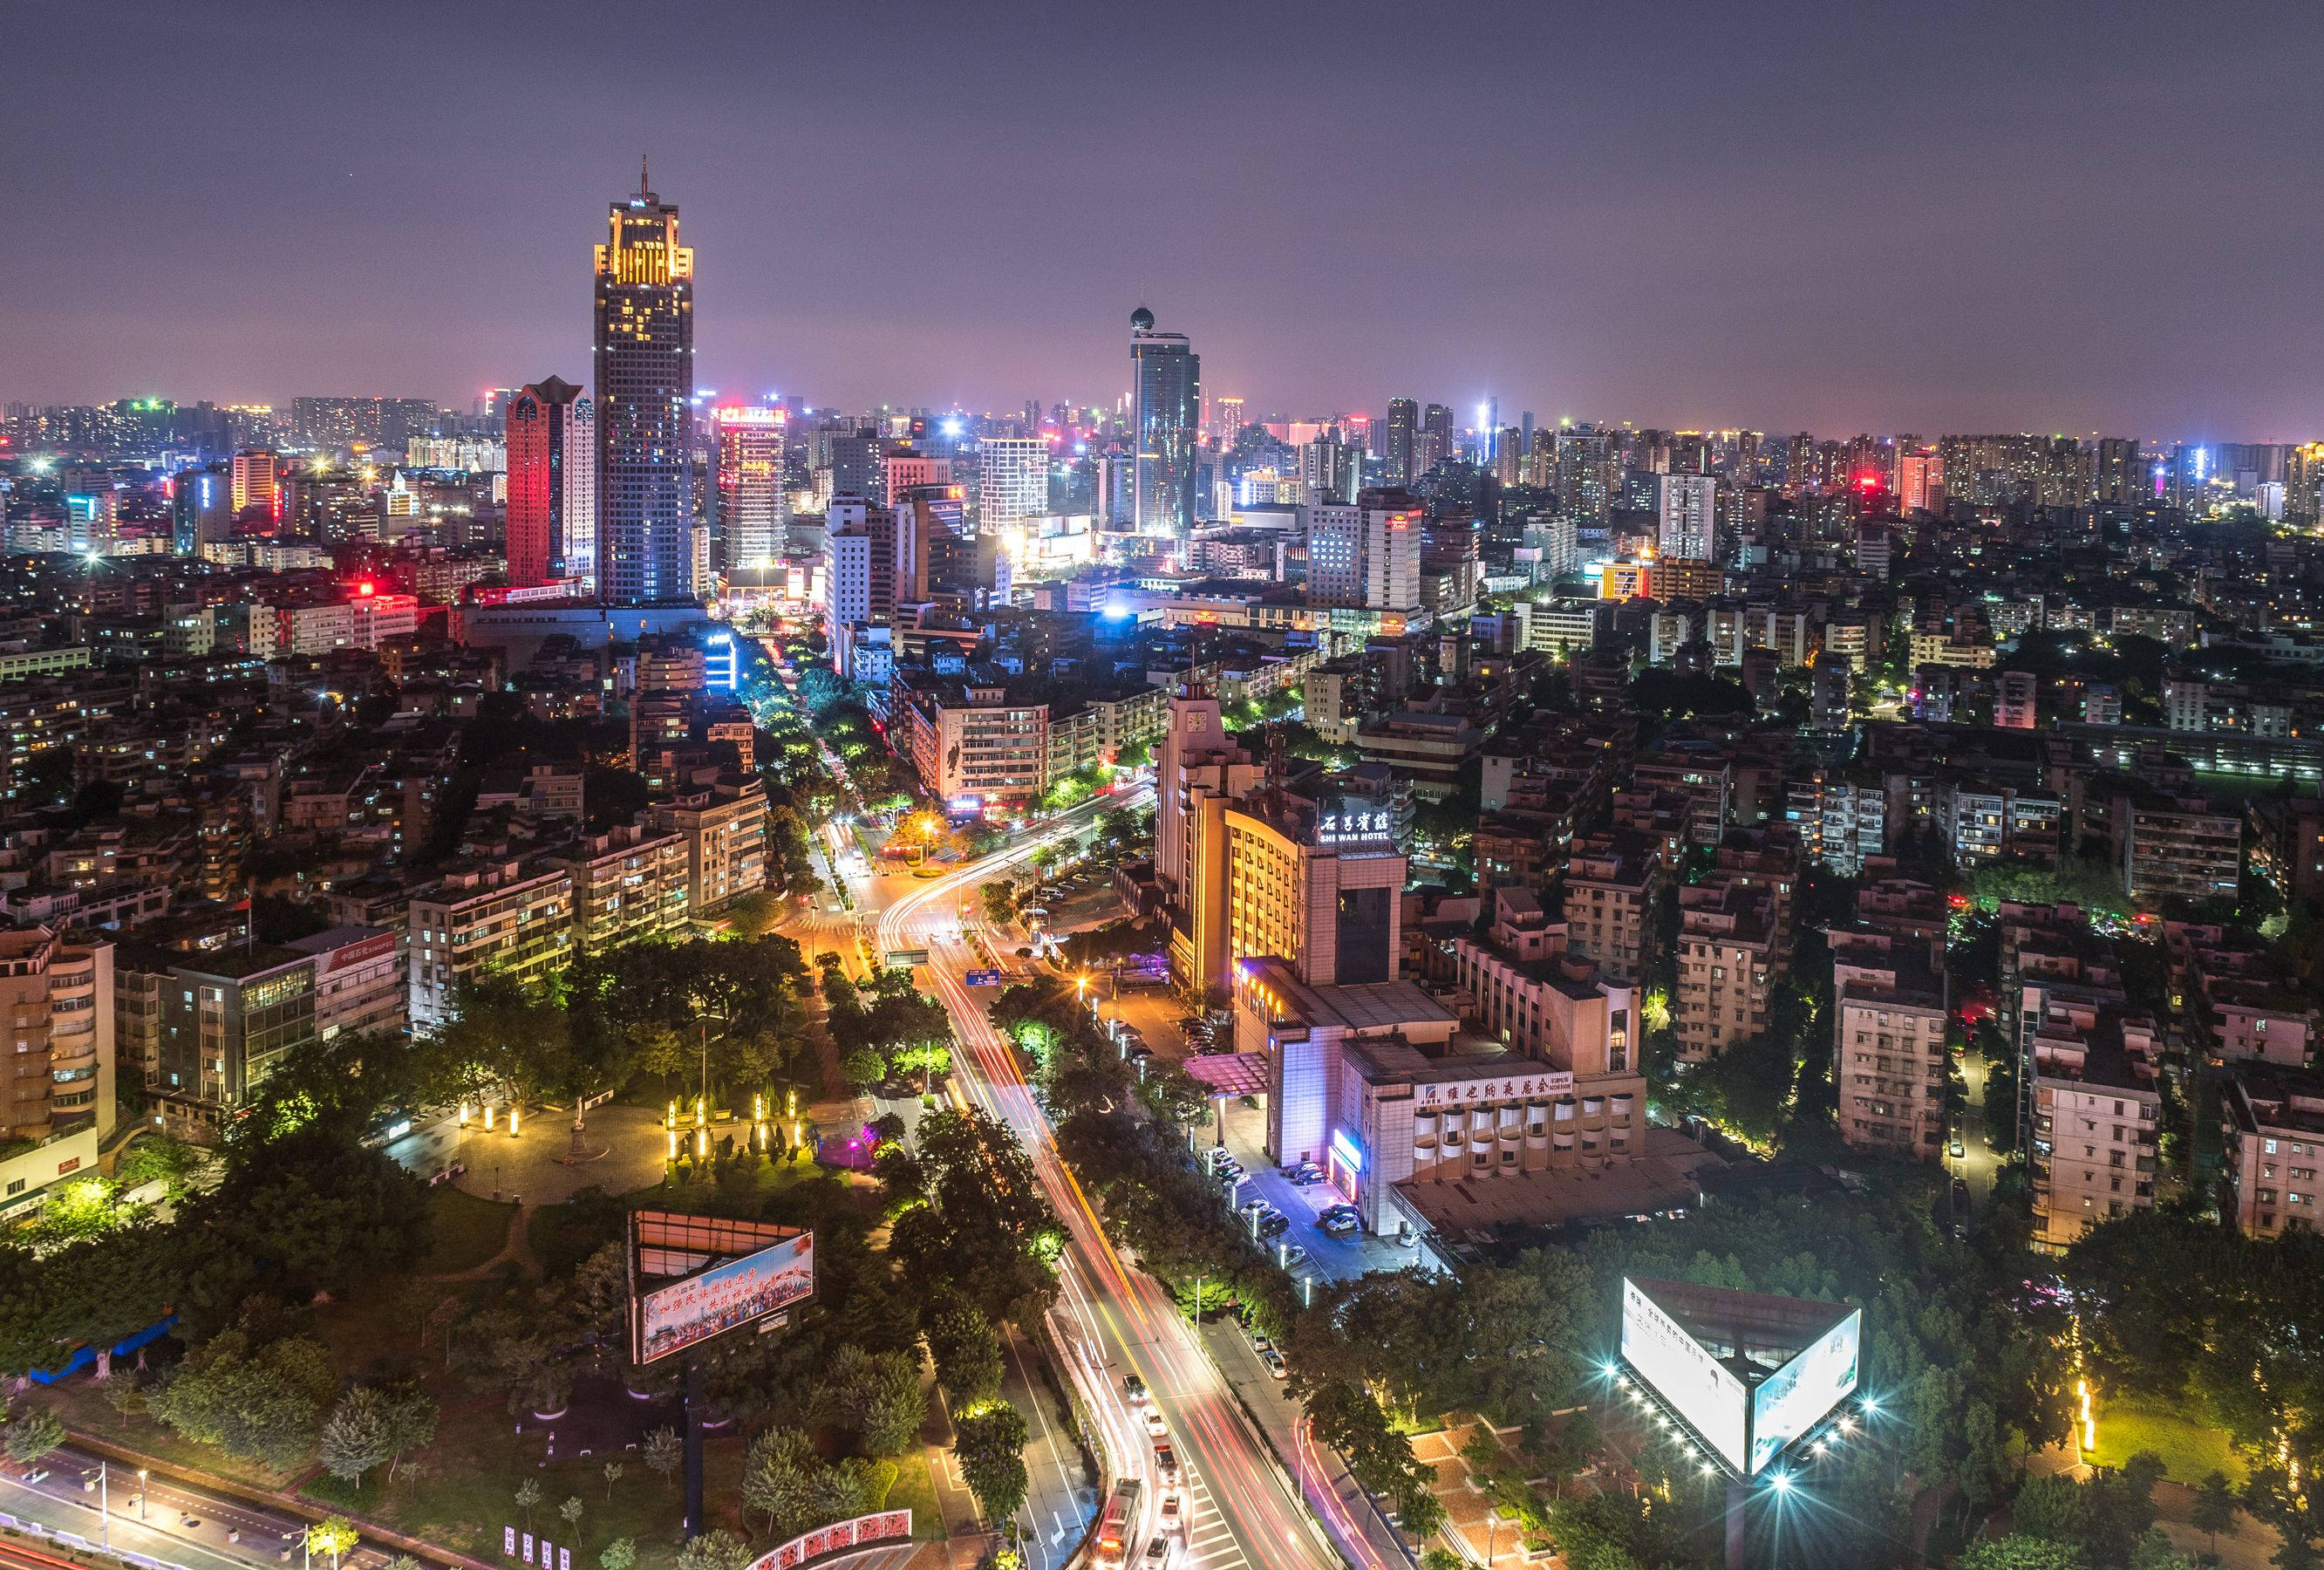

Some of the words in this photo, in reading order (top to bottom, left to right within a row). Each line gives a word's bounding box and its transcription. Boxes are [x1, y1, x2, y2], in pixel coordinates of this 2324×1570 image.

[1320, 834, 1336, 843] SHI
[1339, 834, 1359, 843] WAN
[1360, 832, 1389, 841] HOTEL
[368, 940, 393, 952] SINOPEC
[659, 1267, 758, 1314] 加强民族团结进步
